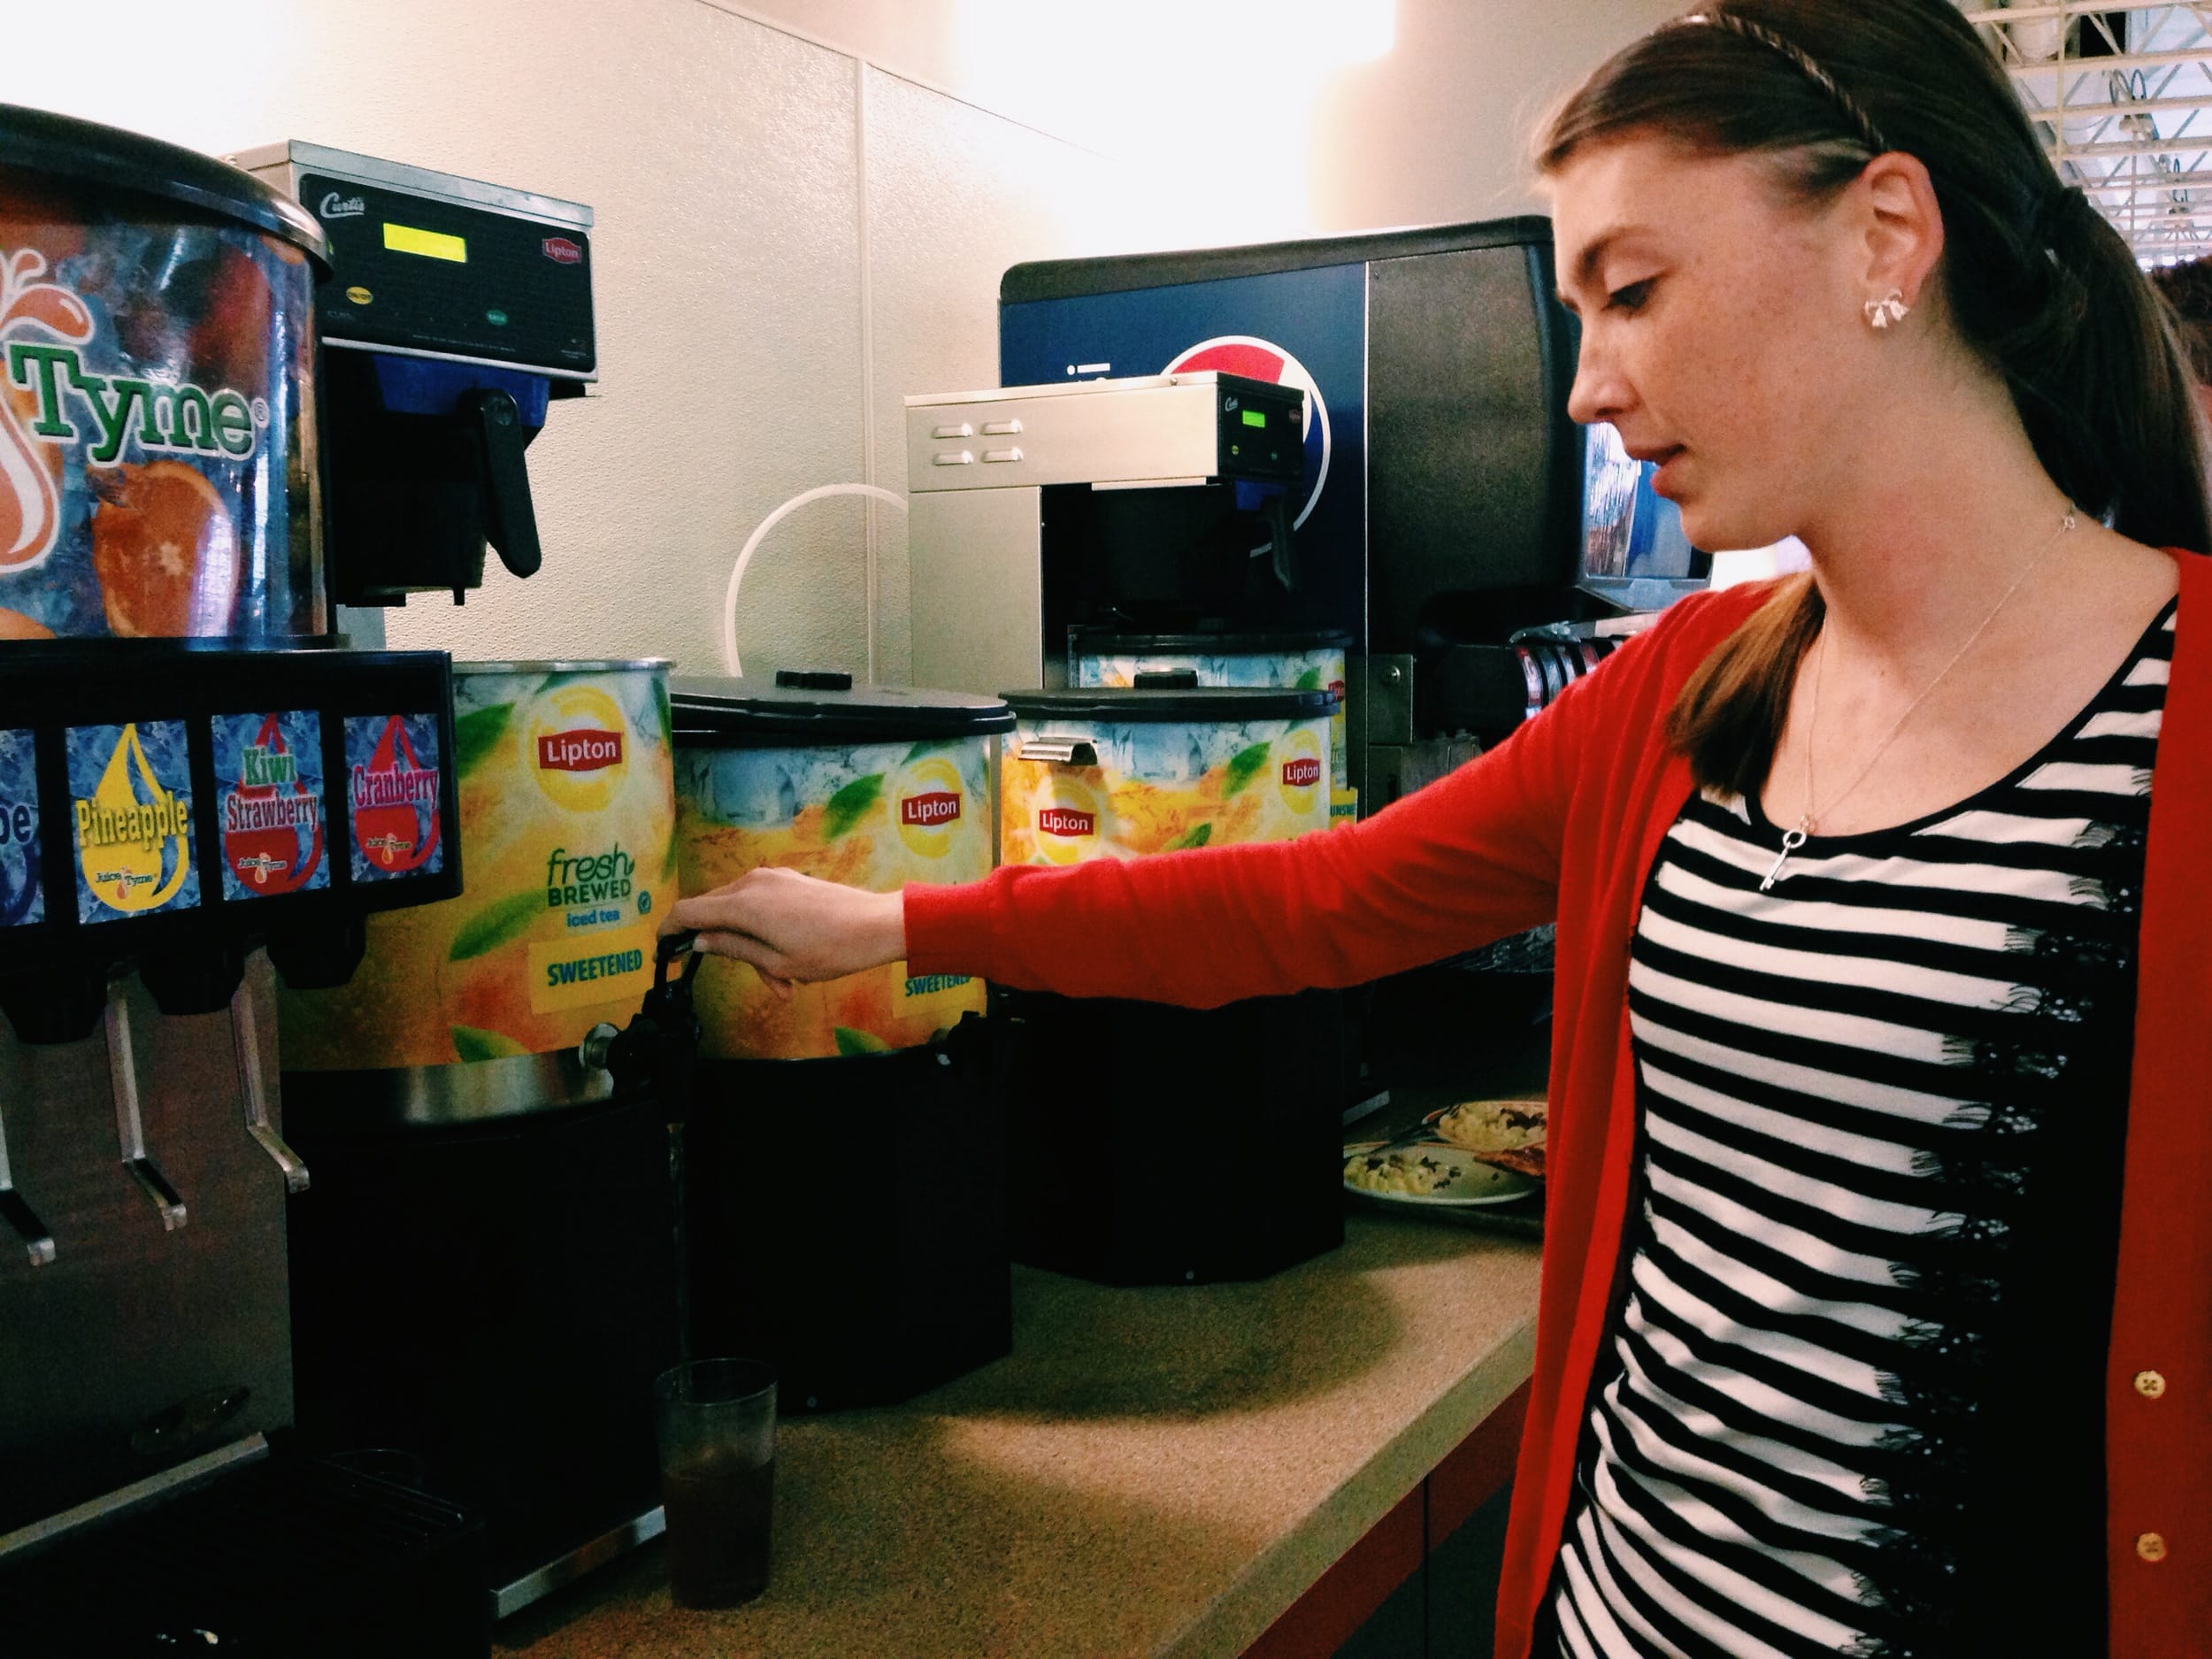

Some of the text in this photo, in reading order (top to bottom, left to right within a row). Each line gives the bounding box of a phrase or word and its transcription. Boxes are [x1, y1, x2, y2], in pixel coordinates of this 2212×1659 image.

[545, 242, 580, 258] Lipton
[547, 738, 617, 767] Lipton
[242, 748, 298, 786] Kiwi
[1286, 764, 1319, 783] Lipton
[354, 763, 439, 810] Cranberry
[75, 790, 188, 850] Pineapple
[227, 791, 319, 832] Strawberry
[907, 799, 956, 822] Lipton
[1042, 812, 1088, 833] Lipton
[547, 841, 635, 887] fresh
[96, 872, 153, 887] Juice Tyme
[548, 879, 632, 907] BREWED
[566, 909, 620, 927] iced tea
[547, 949, 643, 987] SWEETENED
